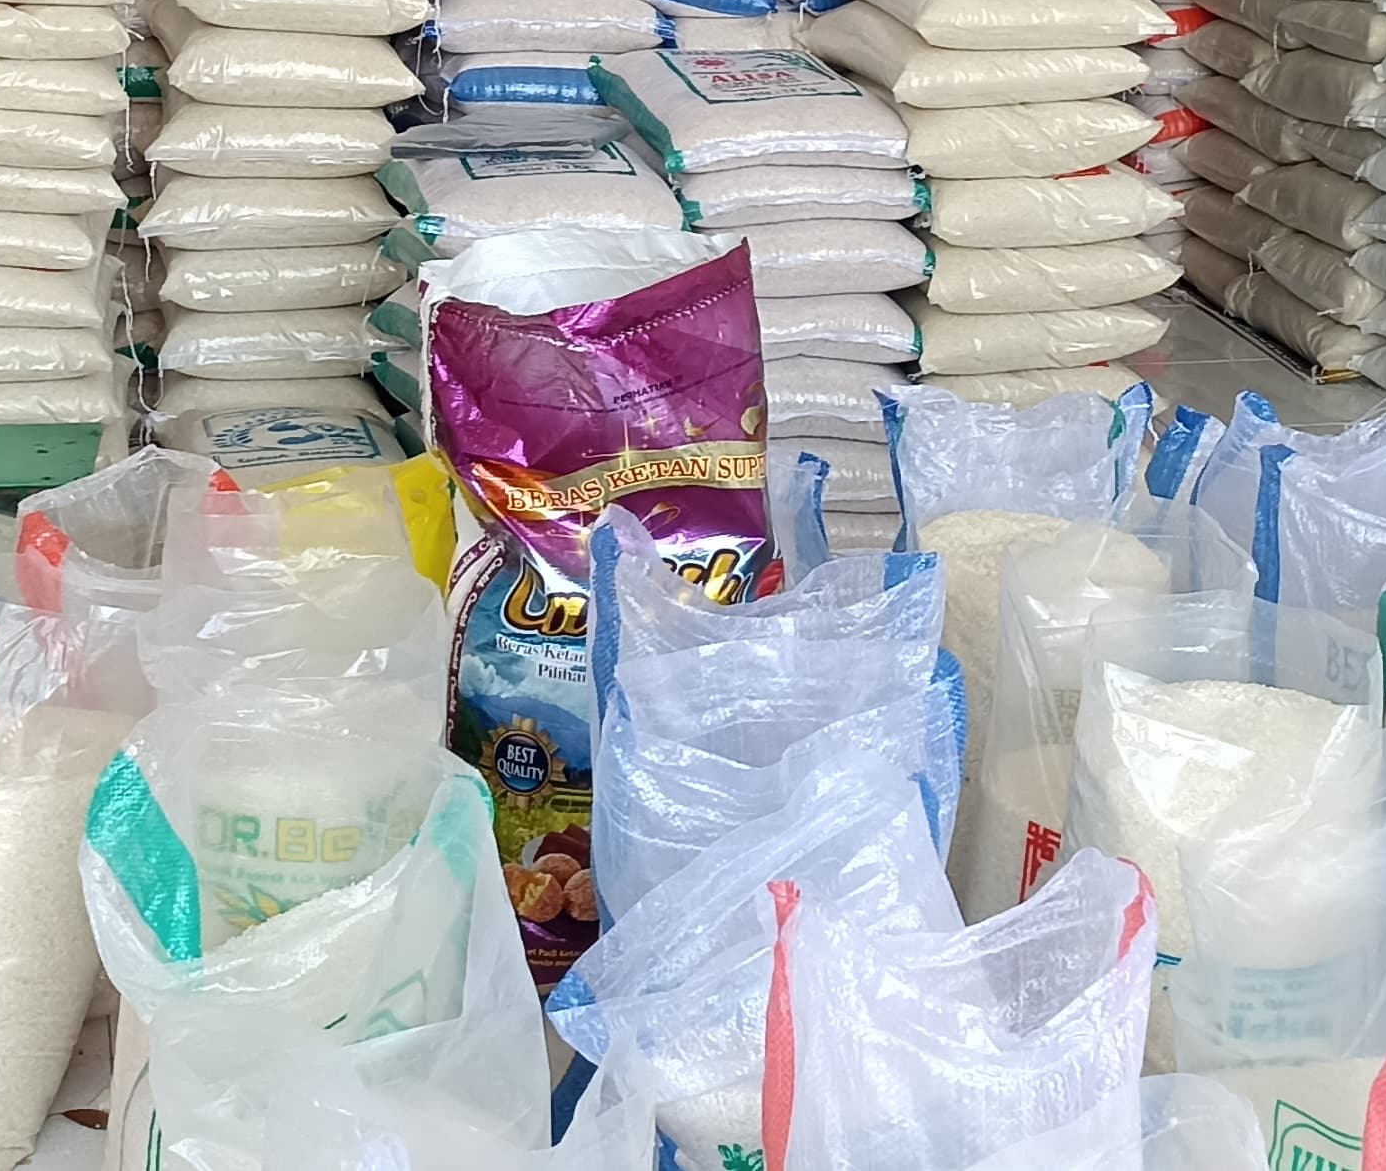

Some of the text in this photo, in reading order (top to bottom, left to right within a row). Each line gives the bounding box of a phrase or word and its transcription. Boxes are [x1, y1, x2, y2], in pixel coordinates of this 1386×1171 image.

[507, 479, 604, 512] BERAS
[604, 457, 711, 491] KETAN
[497, 635, 540, 656] Beras
[507, 744, 537, 764] BEST
[497, 758, 545, 781] QUALITY
